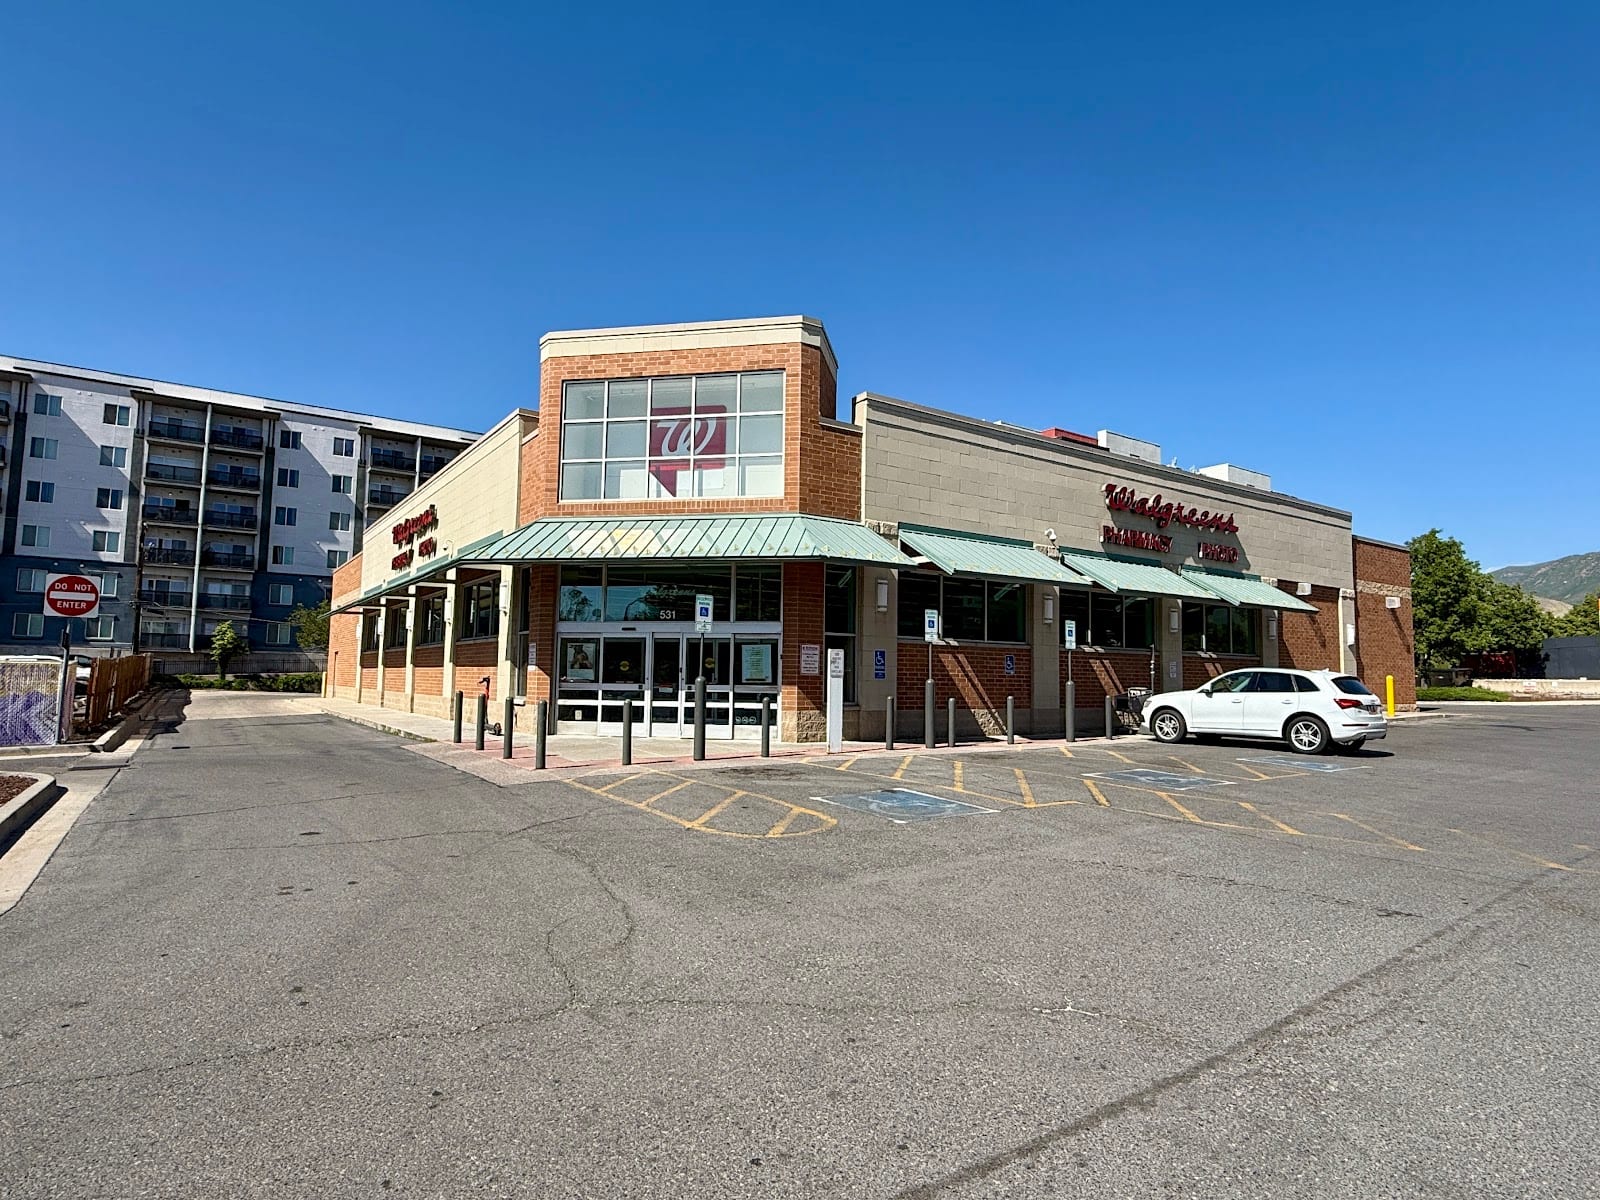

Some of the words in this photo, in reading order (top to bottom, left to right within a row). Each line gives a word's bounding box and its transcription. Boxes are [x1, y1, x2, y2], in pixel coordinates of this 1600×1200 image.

[1101, 483, 1239, 533] Walgreens
[1102, 525, 1172, 552] PHARMACY
[1201, 542, 1239, 563] PHOTO
[74, 584, 92, 592] NOT
[56, 601, 87, 609] ENTER
[659, 610, 676, 620] 531
